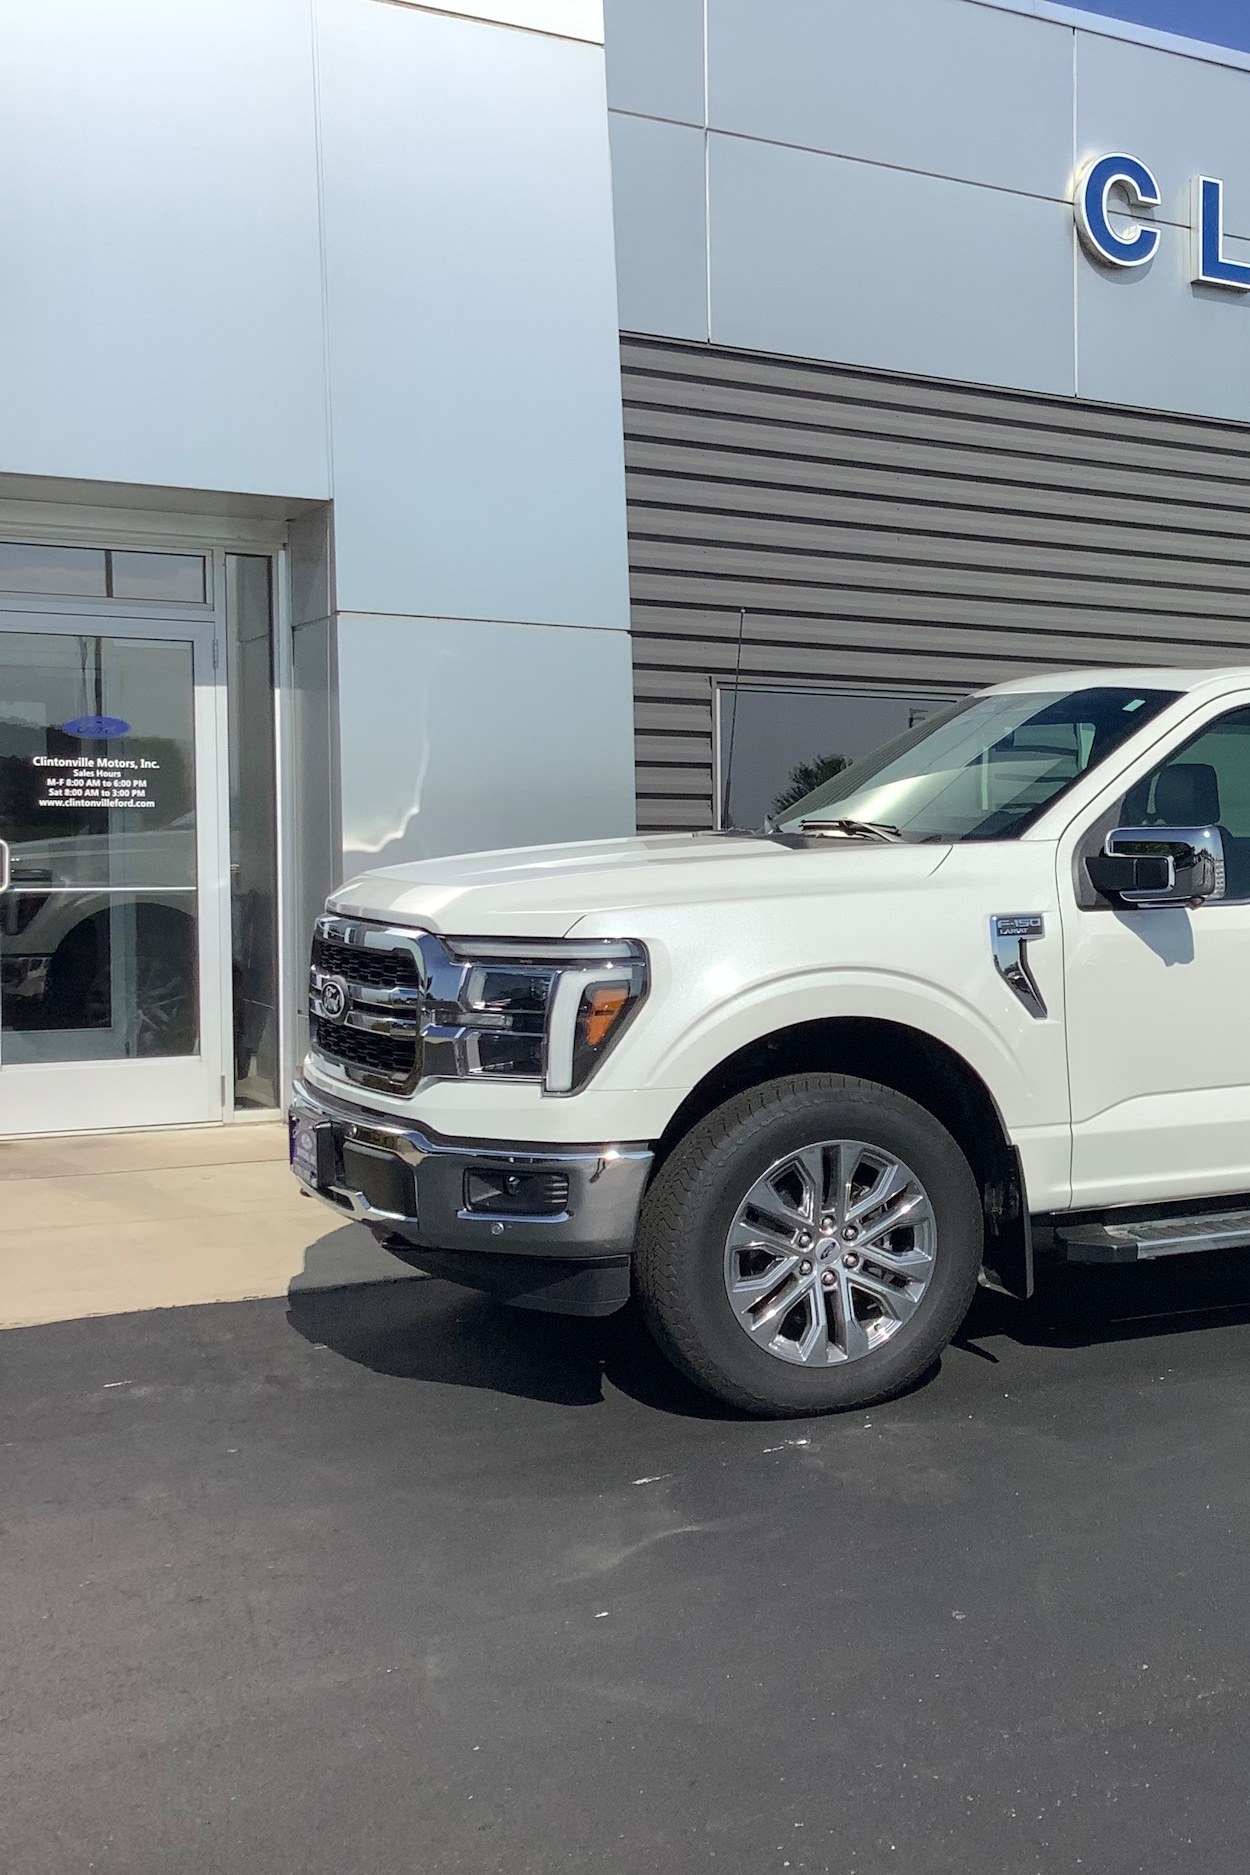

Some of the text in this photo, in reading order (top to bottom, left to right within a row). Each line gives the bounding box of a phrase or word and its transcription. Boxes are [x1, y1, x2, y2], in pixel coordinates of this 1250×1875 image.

[33, 756, 160, 769] Clintonville Motors, Inc.
[73, 769, 122, 778] Sales Hours
[46, 778, 147, 788] M-F 8:00 AM to 6:00 PM
[48, 788, 63, 796] Sat
[64, 788, 82, 797] 8:00
[84, 789, 99, 797] AM
[101, 789, 110, 797] to
[112, 789, 130, 797] 3:00
[38, 799, 156, 808] www.clintonvilleford.com
[997, 918, 1041, 928] F-150
